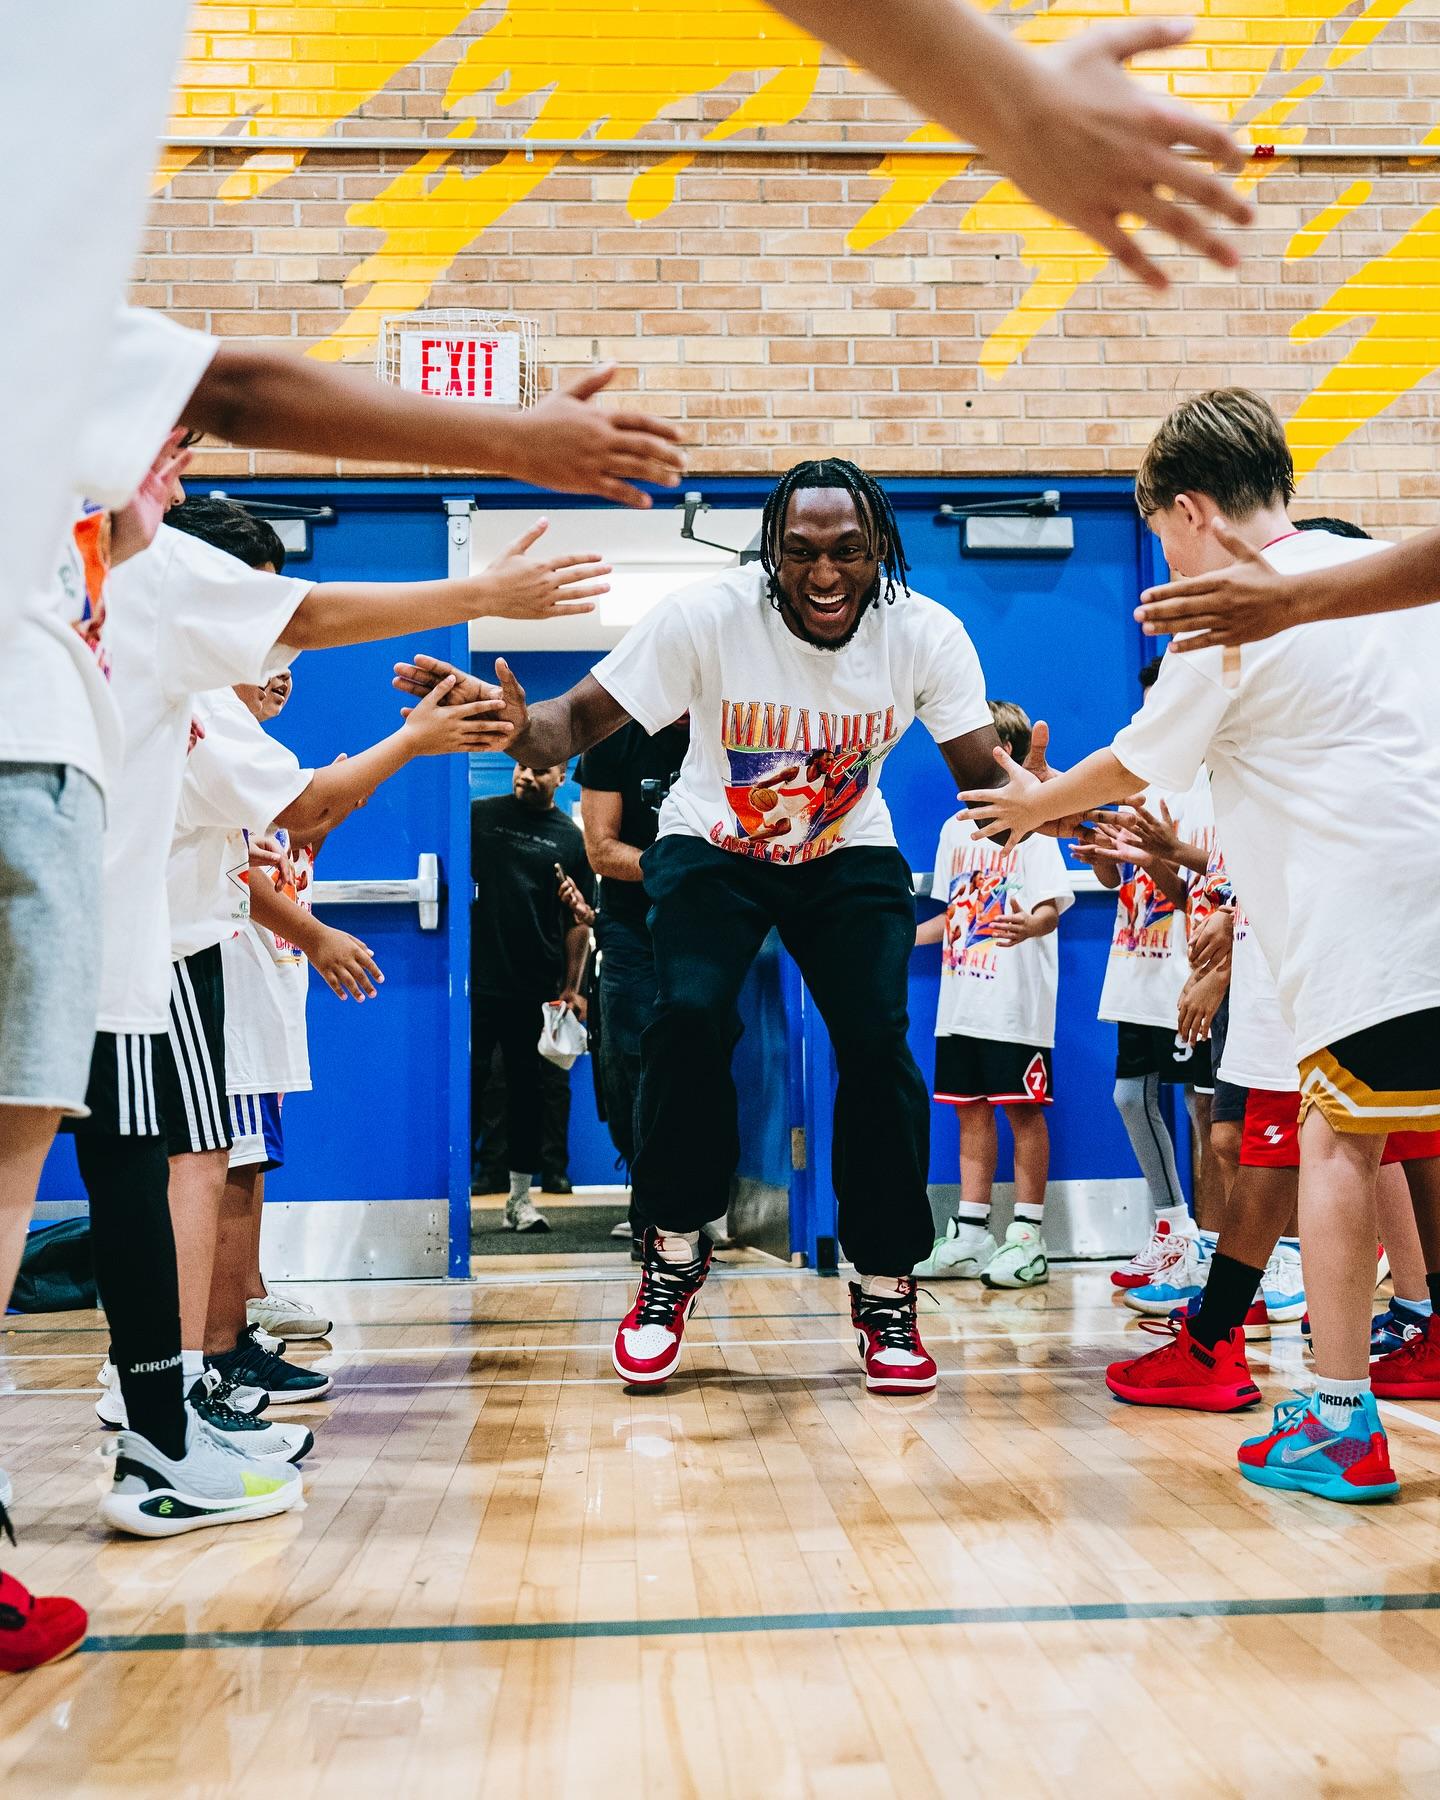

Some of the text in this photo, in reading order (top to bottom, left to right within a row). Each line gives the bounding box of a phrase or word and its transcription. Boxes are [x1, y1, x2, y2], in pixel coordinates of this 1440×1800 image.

[421, 340, 499, 397] EXIT
[721, 699, 898, 754] IMMANUEL
[1030, 1071, 1043, 1091] 7
[1318, 1392, 1364, 1408] ORDAN
